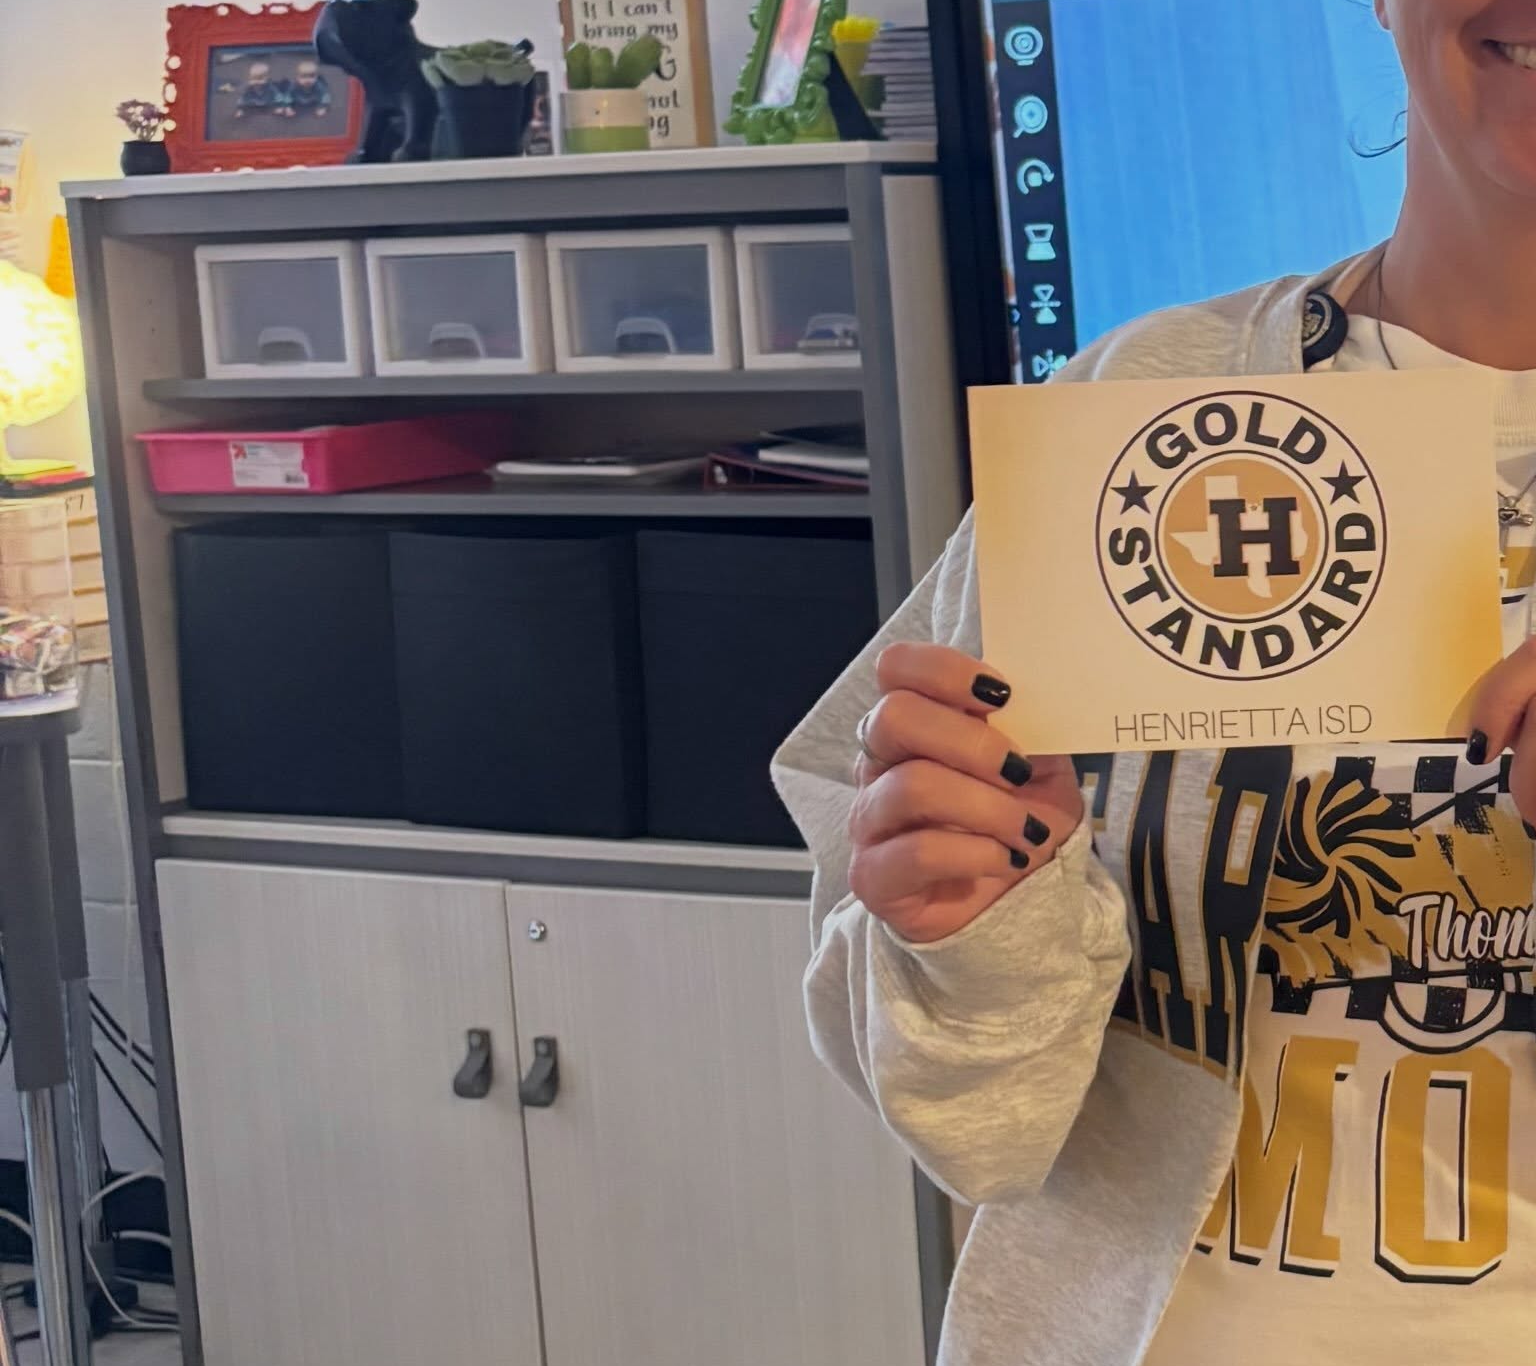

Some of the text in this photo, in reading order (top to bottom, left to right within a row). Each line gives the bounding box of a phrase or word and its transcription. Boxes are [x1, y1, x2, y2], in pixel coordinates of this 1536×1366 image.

[1144, 401, 1327, 470] GOLD
[1209, 497, 1301, 577] H
[1108, 512, 1376, 671] STANDARD
[1115, 704, 1373, 744] HENRIETTA ISD
